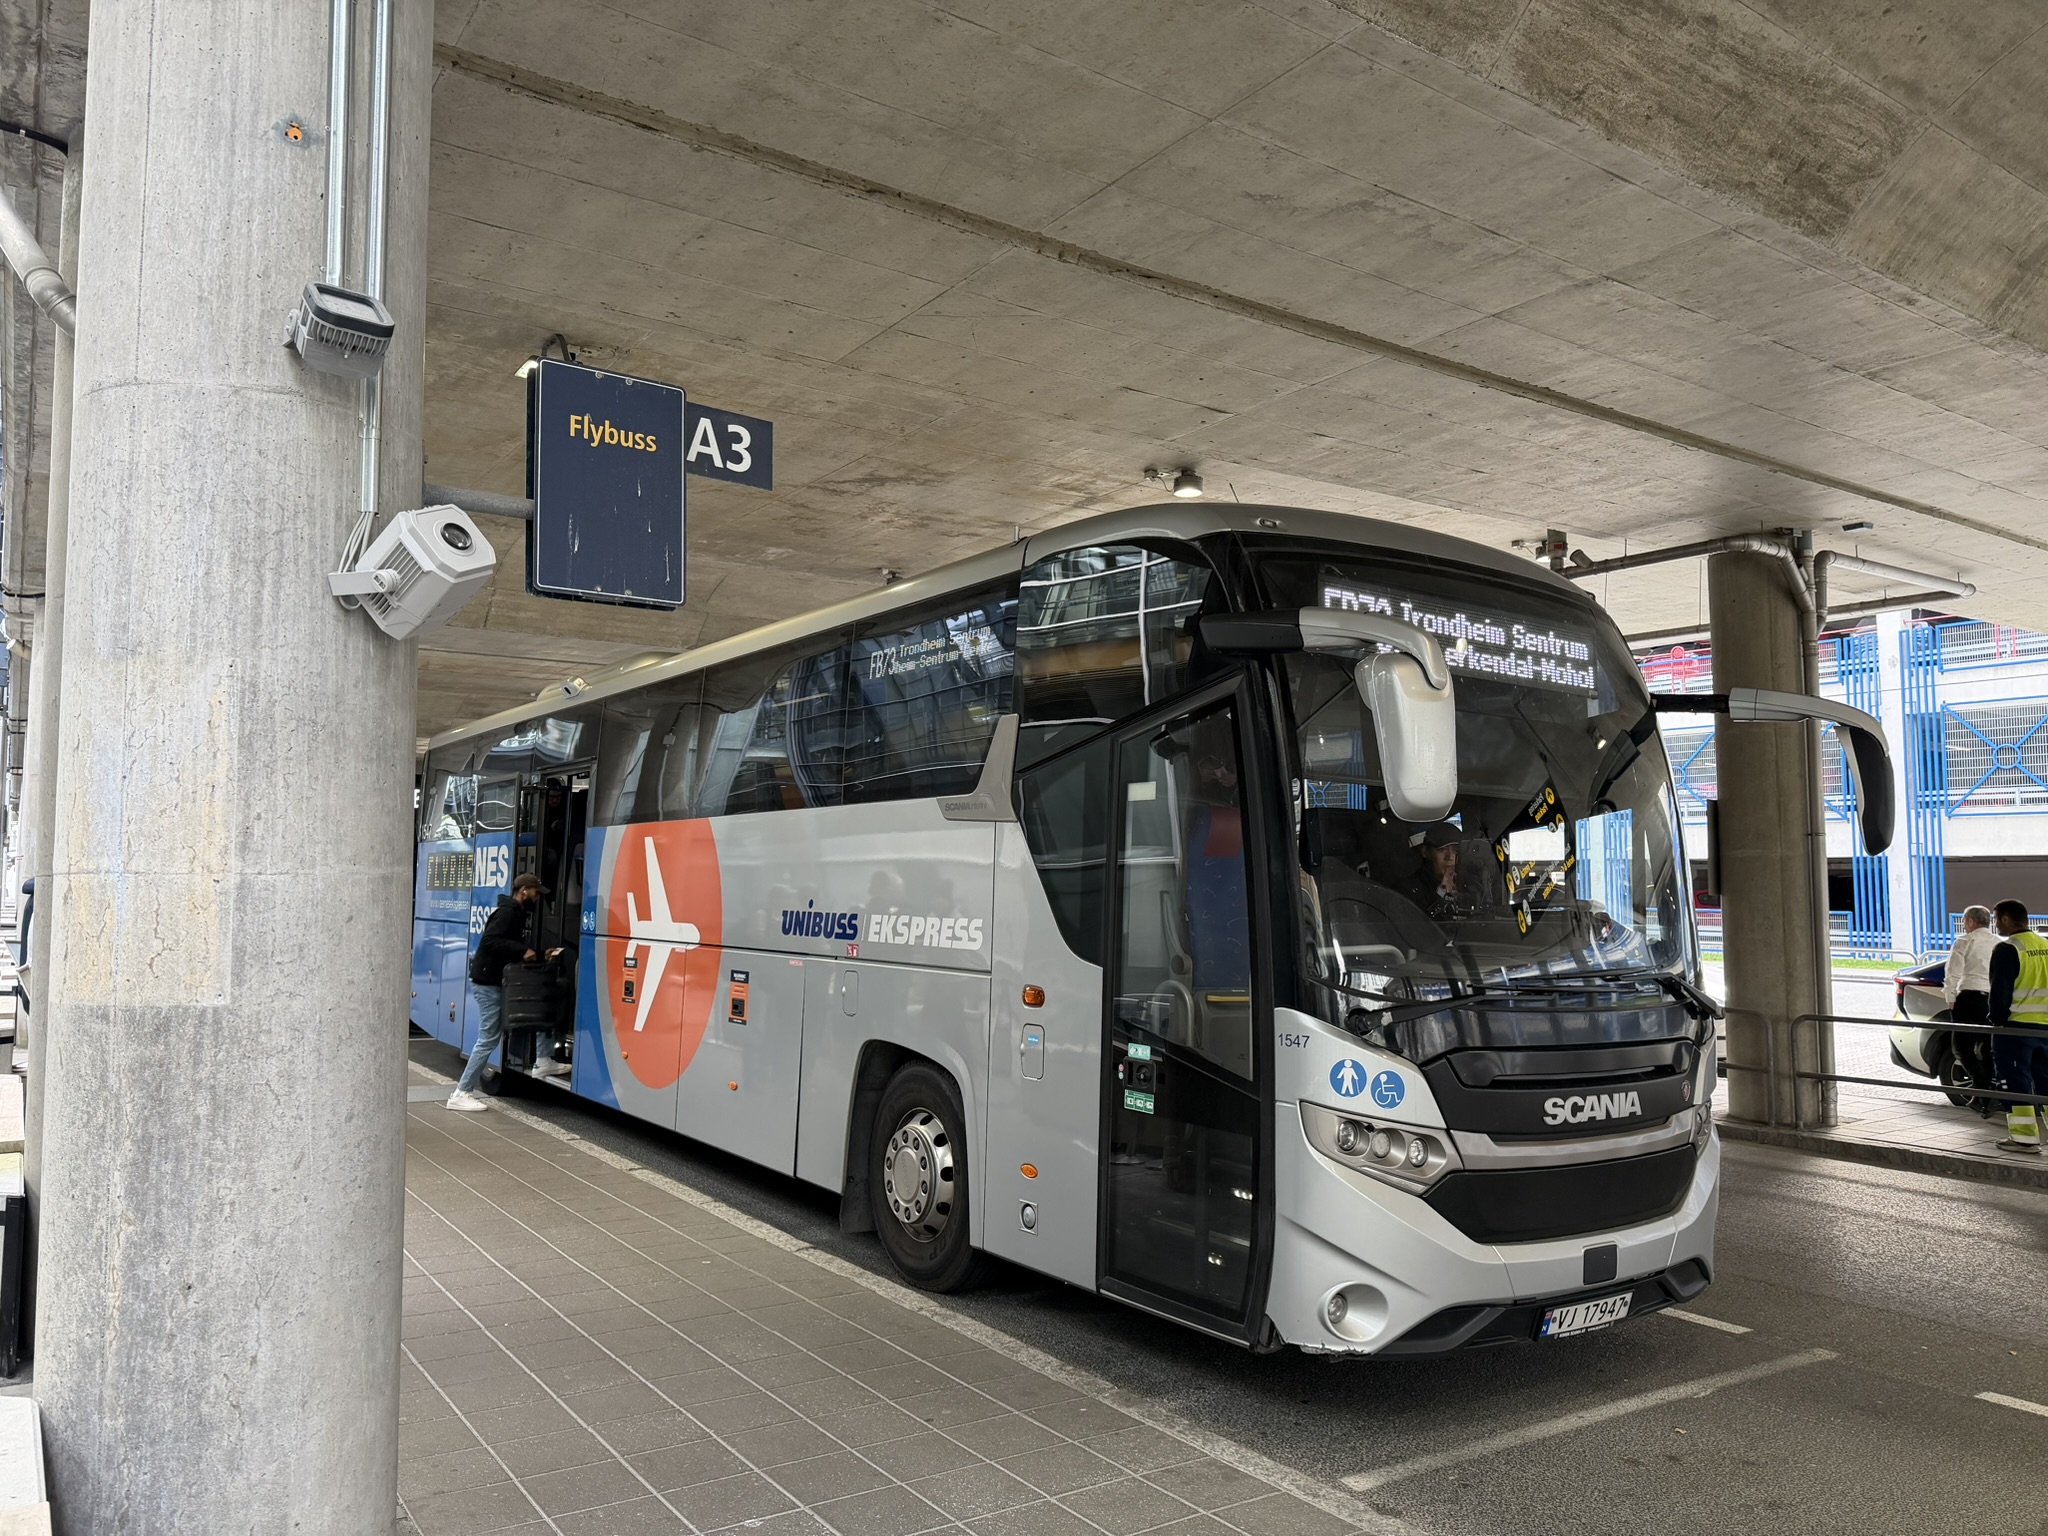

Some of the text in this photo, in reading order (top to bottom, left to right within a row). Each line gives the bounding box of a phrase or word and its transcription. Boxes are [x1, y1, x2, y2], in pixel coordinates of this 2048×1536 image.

[569, 414, 657, 452] Flybuss
[686, 417, 752, 473] A3
[869, 625, 991, 679] FB73 Trondheim Sentrum
[1400, 602, 1505, 645] Trondheim
[1512, 624, 1589, 661] Sentrum
[1444, 644, 1595, 690] erkendal-Mohol
[944, 801, 971, 811] SCANIA
[473, 844, 509, 888] NES
[782, 899, 984, 951] UNIBUSS EKSPRESS
[1277, 1033, 1310, 1048] 1547
[1543, 1091, 1642, 1125] SCANIA
[1558, 1296, 1626, 1330] VJ 17947
